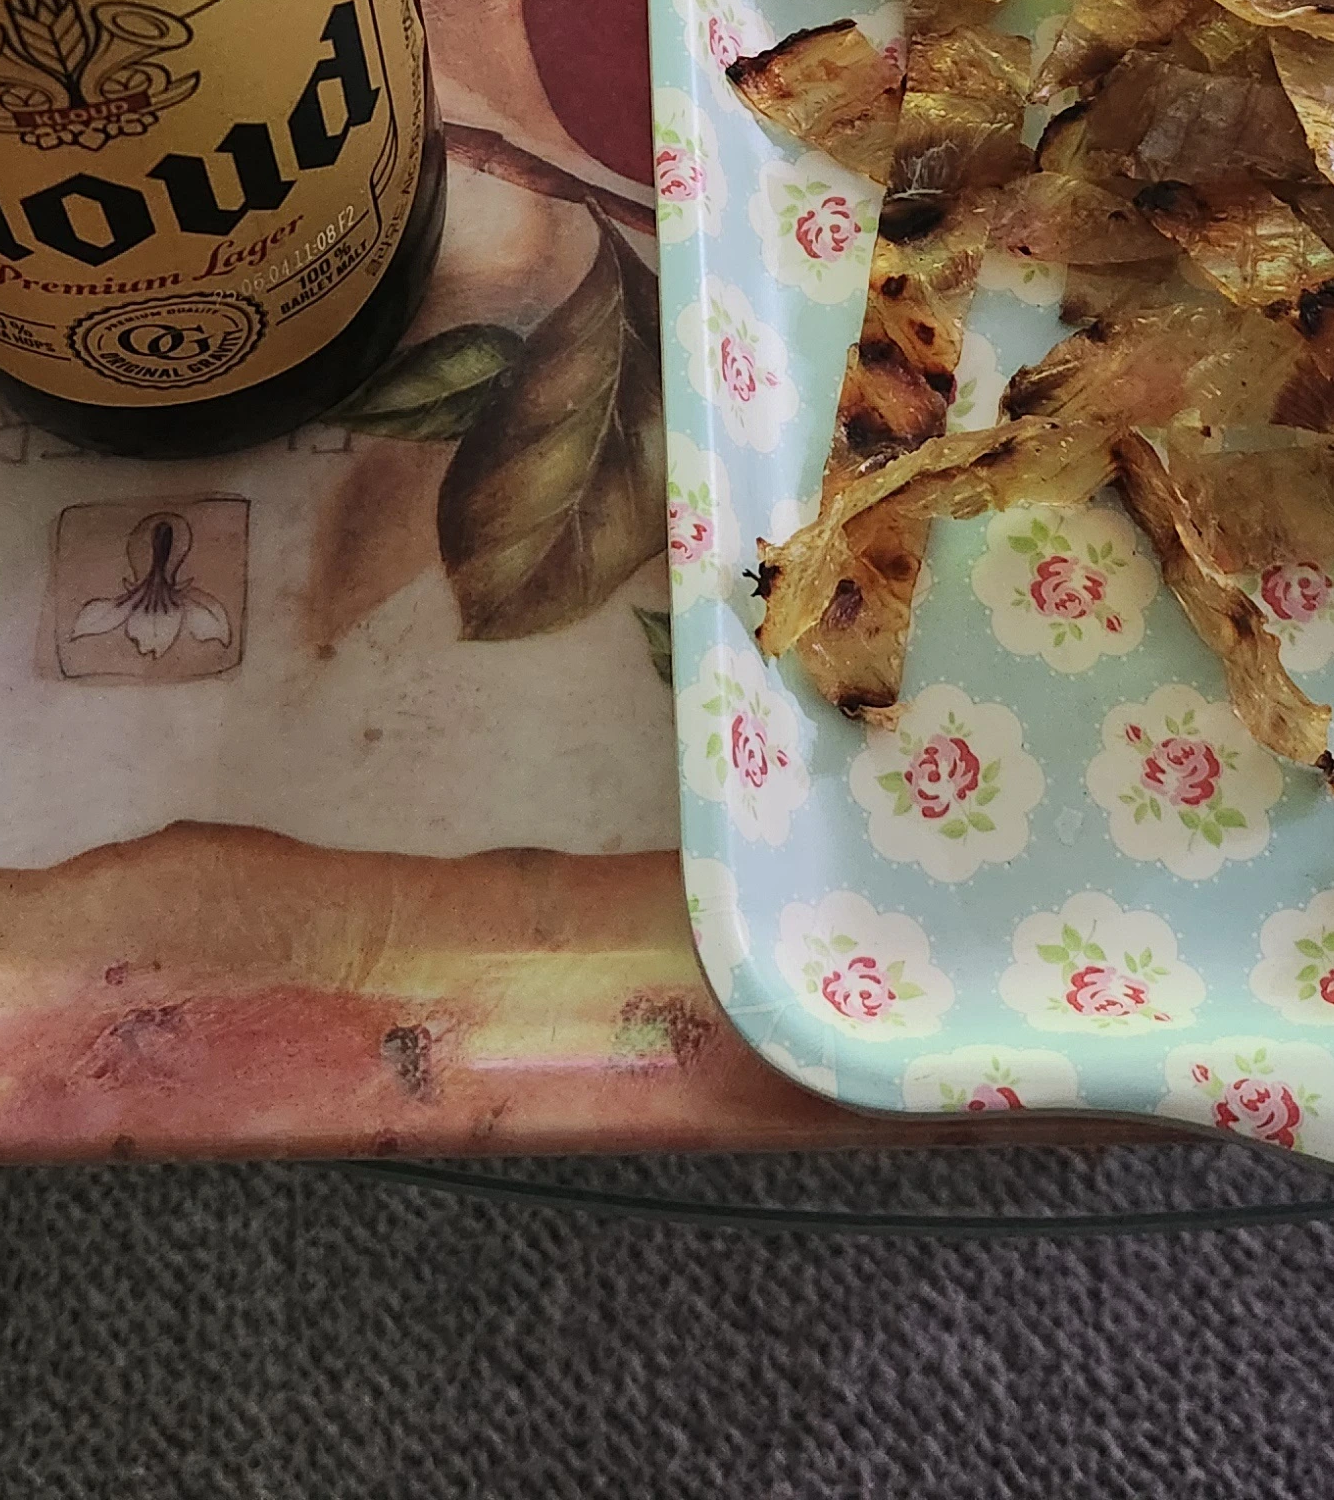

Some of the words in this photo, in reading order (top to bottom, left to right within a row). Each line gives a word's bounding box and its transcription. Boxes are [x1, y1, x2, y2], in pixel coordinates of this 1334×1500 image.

[34, 101, 129, 127] KLOUD
[338, 205, 355, 234] F2
[192, 214, 304, 282] Lager
[280, 271, 333, 315] BARLEY
[336, 238, 367, 277] MALT
[297, 258, 331, 290] 100
[99, 352, 185, 379] ORIGINAL
[186, 328, 245, 373] GRAVITY
[117, 324, 214, 361] OG
